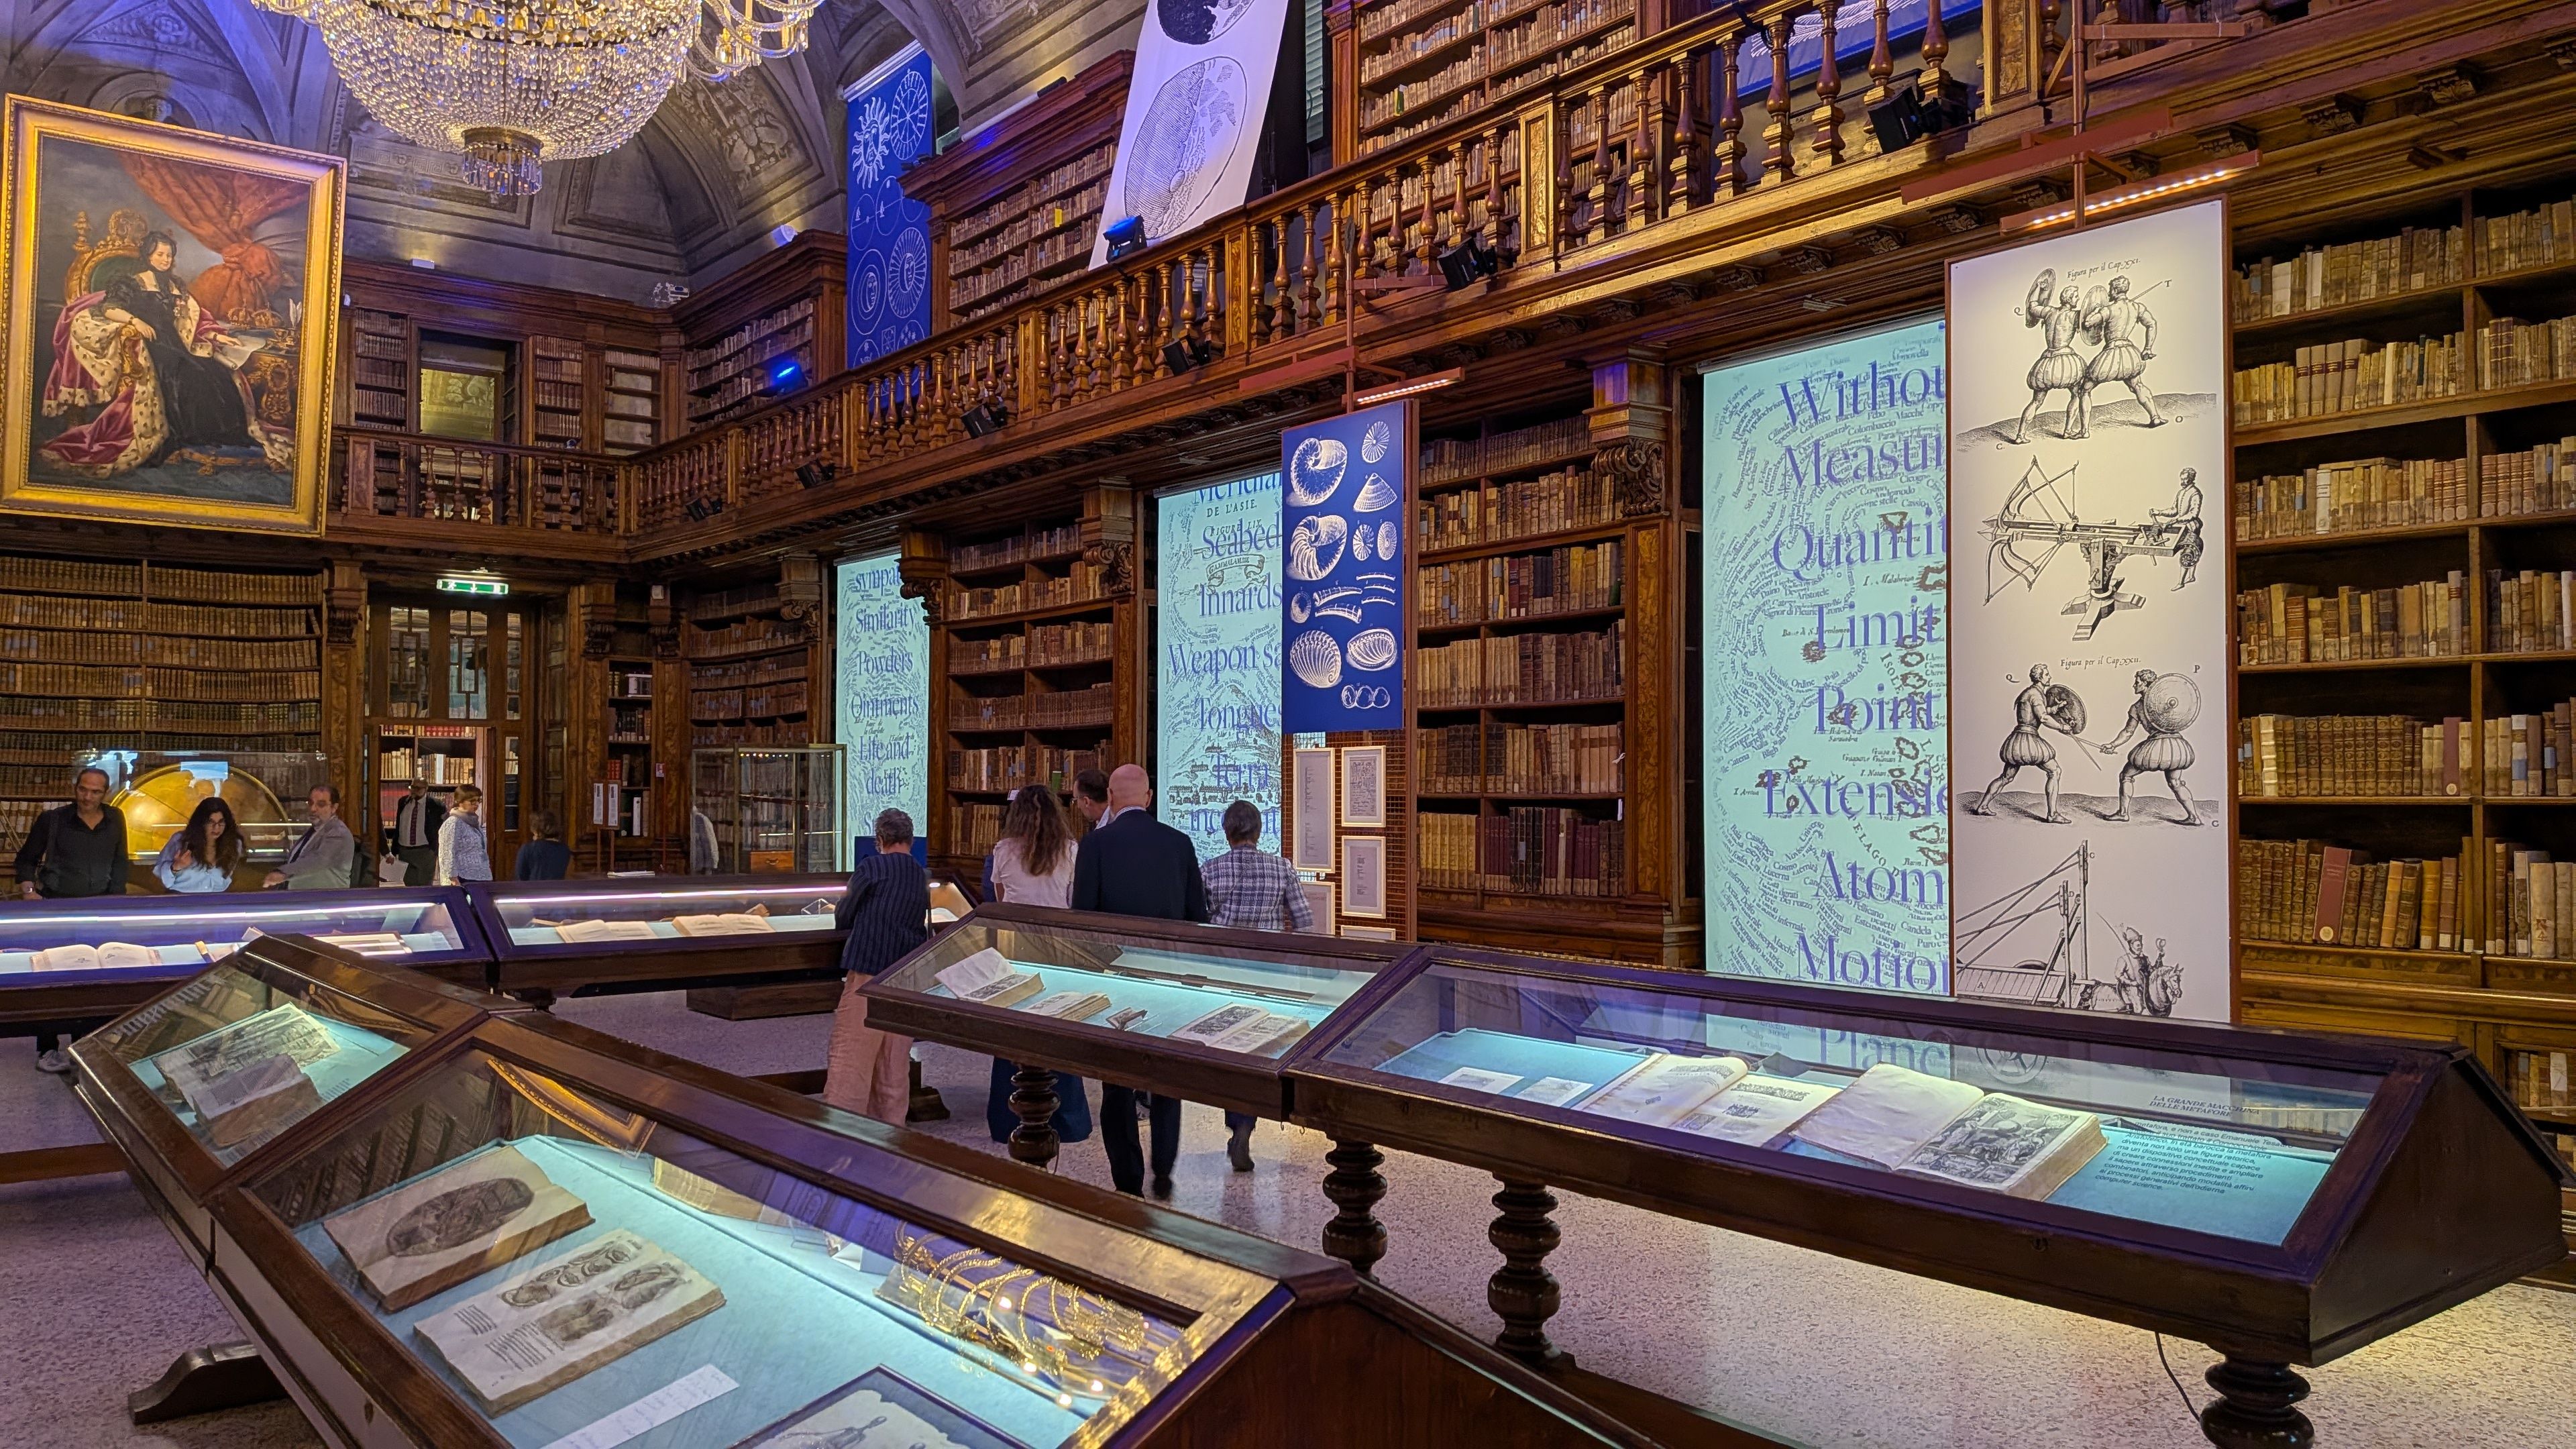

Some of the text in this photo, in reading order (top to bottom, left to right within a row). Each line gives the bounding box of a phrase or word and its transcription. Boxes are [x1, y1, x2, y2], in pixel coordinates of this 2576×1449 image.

[2067, 269, 2087, 281] Figura
[2088, 266, 2099, 278] per
[2101, 262, 2106, 270] il
[2164, 279, 2172, 287] T
[1207, 506, 1220, 518] DE
[1201, 511, 1282, 560] Seabed
[1199, 572, 1282, 617] Innards
[1812, 595, 1945, 651] Limit
[859, 646, 913, 676] Powders
[1167, 643, 1259, 685] Weapon
[2060, 657, 2082, 669] Figura
[2084, 659, 2095, 669] per
[2098, 655, 2103, 665] il
[2193, 665, 2200, 673] P
[2006, 674, 2019, 684] Q
[1814, 683, 1937, 734] Point
[1811, 851, 1947, 904] Atom
[1900, 921, 1932, 935] Candela
[2149, 1101, 2233, 1117] DELLE METAFORE
[2167, 1097, 2206, 1108] GRANDE
[2208, 1103, 2259, 1115] MACCHINA
[2220, 1134, 2260, 1144] Emanuele
[2122, 1139, 2149, 1147] diventa
[2201, 1150, 2223, 1159] figura
[2194, 1142, 2226, 1152] barocca
[2235, 1150, 2272, 1159] metafora
[2114, 1157, 2140, 1166] sapere
[2141, 1161, 2179, 1173] attraverso
[2179, 1168, 2233, 1181] procedimenti
[2122, 1152, 2145, 1160] creare
[2147, 1157, 2193, 1167] connessioni
[2194, 1164, 2220, 1172] inedite
[2229, 1169, 2264, 1179] ampliare
[2142, 1149, 2182, 1159] dispositivo
[2184, 1155, 2230, 1167] concettuale
[2231, 1163, 2261, 1172] capace
[2095, 1174, 2163, 1191] computer science.
[2107, 1170, 2141, 1179] processi
[2141, 1175, 2180, 1186] generativi
[2180, 1181, 2225, 1194] dell'odierna
[2151, 1170, 2197, 1183] anticipando
[2198, 1178, 2233, 1188] modalità
